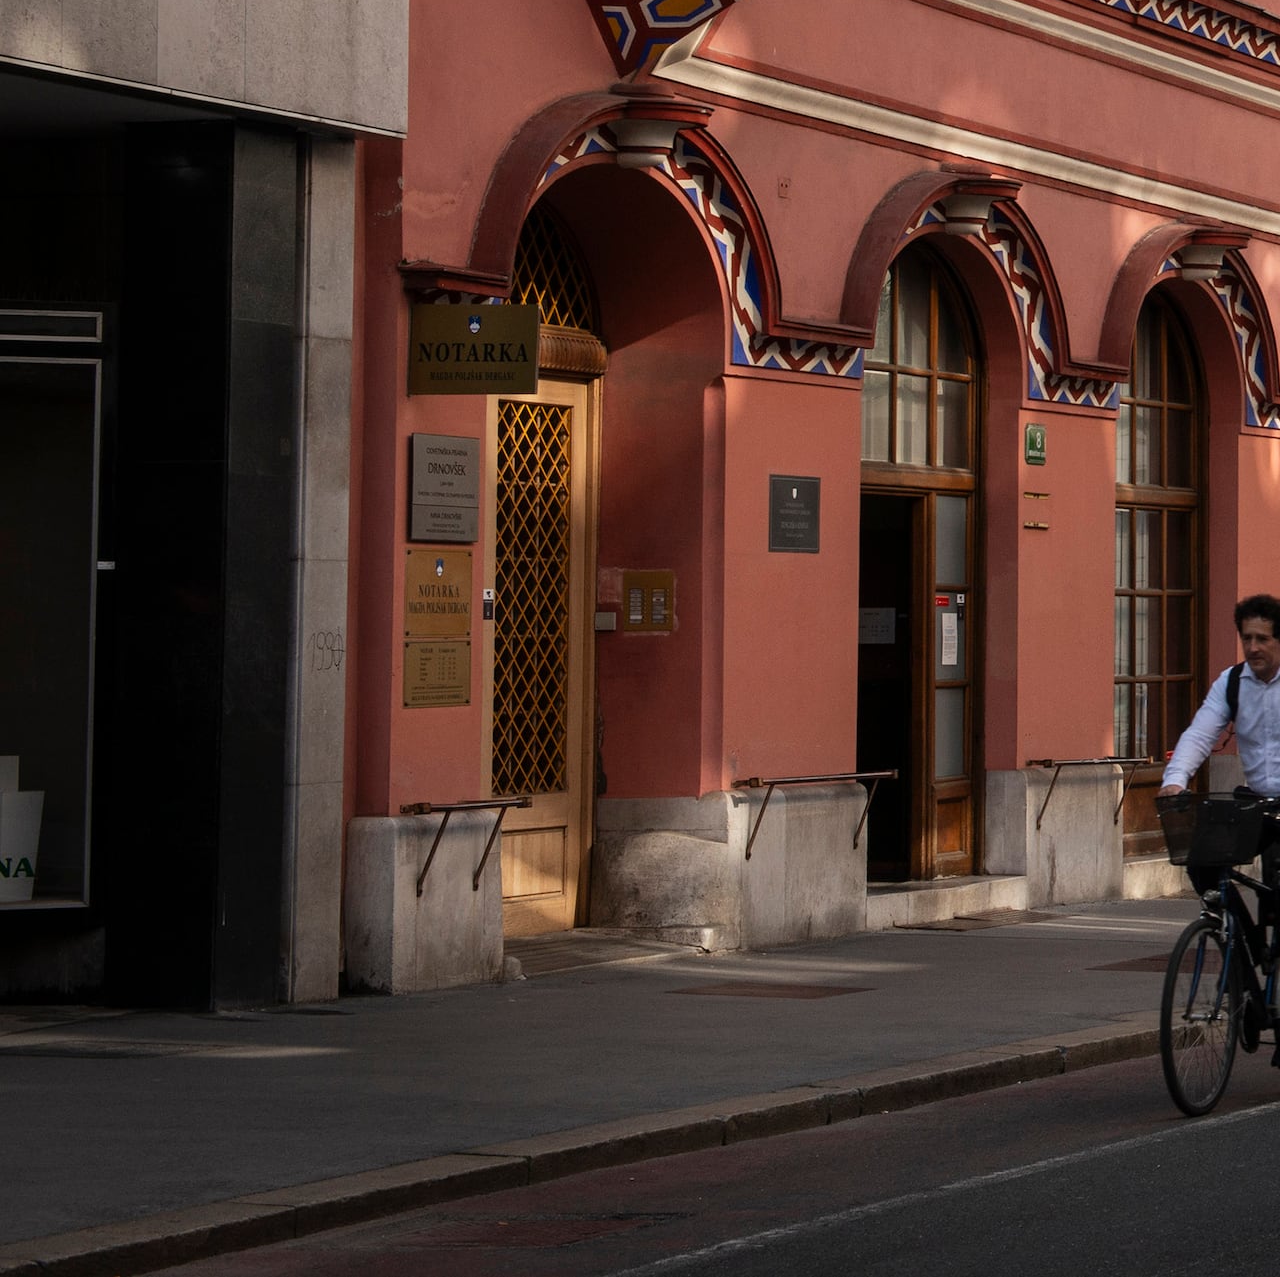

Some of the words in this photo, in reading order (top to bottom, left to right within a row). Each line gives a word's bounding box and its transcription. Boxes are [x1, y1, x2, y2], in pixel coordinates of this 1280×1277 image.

[418, 342, 529, 362] NOTARKA
[1036, 432, 1042, 449] 8
[427, 462, 466, 476] DRNOVŠEK
[418, 584, 460, 598] NOTARKA
